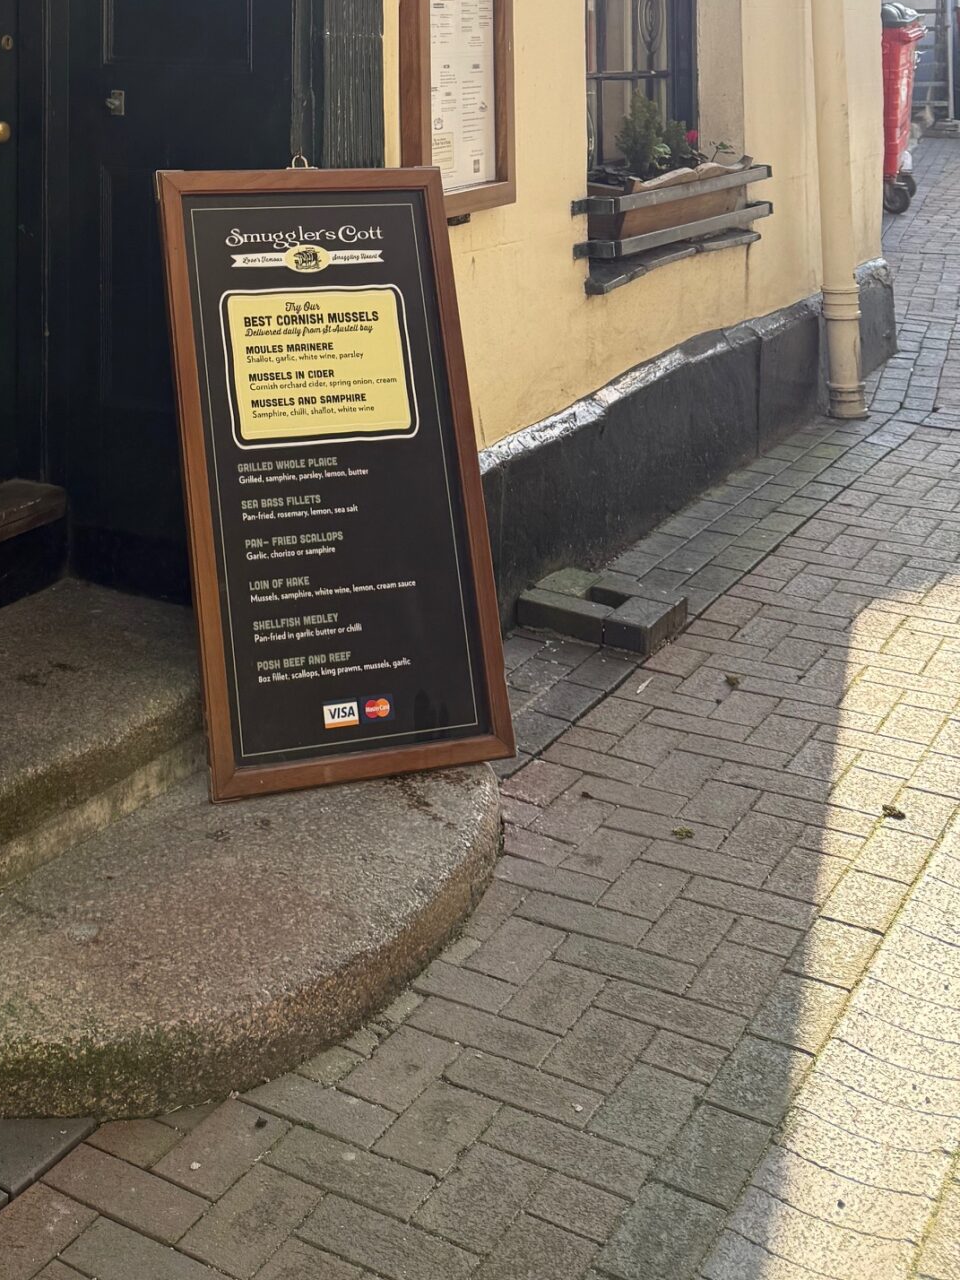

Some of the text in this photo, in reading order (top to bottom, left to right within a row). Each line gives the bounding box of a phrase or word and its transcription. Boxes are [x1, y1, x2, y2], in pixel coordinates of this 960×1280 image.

[226, 225, 384, 249] Smugglers Cott
[285, 301, 320, 314] Try Our
[244, 311, 379, 327] BEST CORNISH MUSSELS
[245, 327, 281, 336] Delivered
[283, 326, 301, 336] daily
[302, 327, 321, 336] from
[333, 324, 358, 333] Austell
[360, 324, 372, 333] bay
[246, 342, 334, 354] MOULES MARINERE
[339, 350, 363, 359] parsley
[249, 369, 335, 382] MUSSELS IN CIDER
[250, 382, 278, 391] Cornish
[280, 381, 307, 389] orchard
[308, 380, 327, 388] cider,
[251, 393, 366, 408] MUSSELS AND SAMPHIRE
[253, 410, 288, 419] Samphire,
[238, 457, 338, 473] GRILLED WHOLE PLAICE
[348, 468, 368, 476] butter
[241, 495, 321, 509] SEA BASS FILLETS
[347, 504, 358, 512] salt
[245, 531, 343, 548] PAN- FRIED SCALLOPS
[246, 552, 269, 560] Garlic,
[271, 550, 295, 558] chorizo
[306, 546, 335, 556] samphire
[249, 576, 310, 591] LOIN OF HAKE
[250, 594, 279, 603] Mussels,
[281, 590, 313, 600] samphire,
[315, 588, 333, 596] white
[335, 587, 351, 595] wine,
[353, 584, 375, 592] lemon,
[398, 580, 416, 588] sauce
[253, 613, 338, 631] SHELLFISH MEDLEY
[254, 631, 286, 643] Pan-fried
[288, 631, 294, 639] in
[296, 630, 314, 640] garlic
[316, 627, 336, 636] butter
[347, 623, 362, 632] chilli
[257, 651, 351, 671] POSH BEEF AND REEF
[292, 669, 319, 680] scallops,
[321, 667, 335, 676] king
[337, 665, 362, 674] prawns,
[364, 660, 391, 670] mussels,
[393, 657, 411, 668] garlic
[328, 706, 355, 720] VISA
